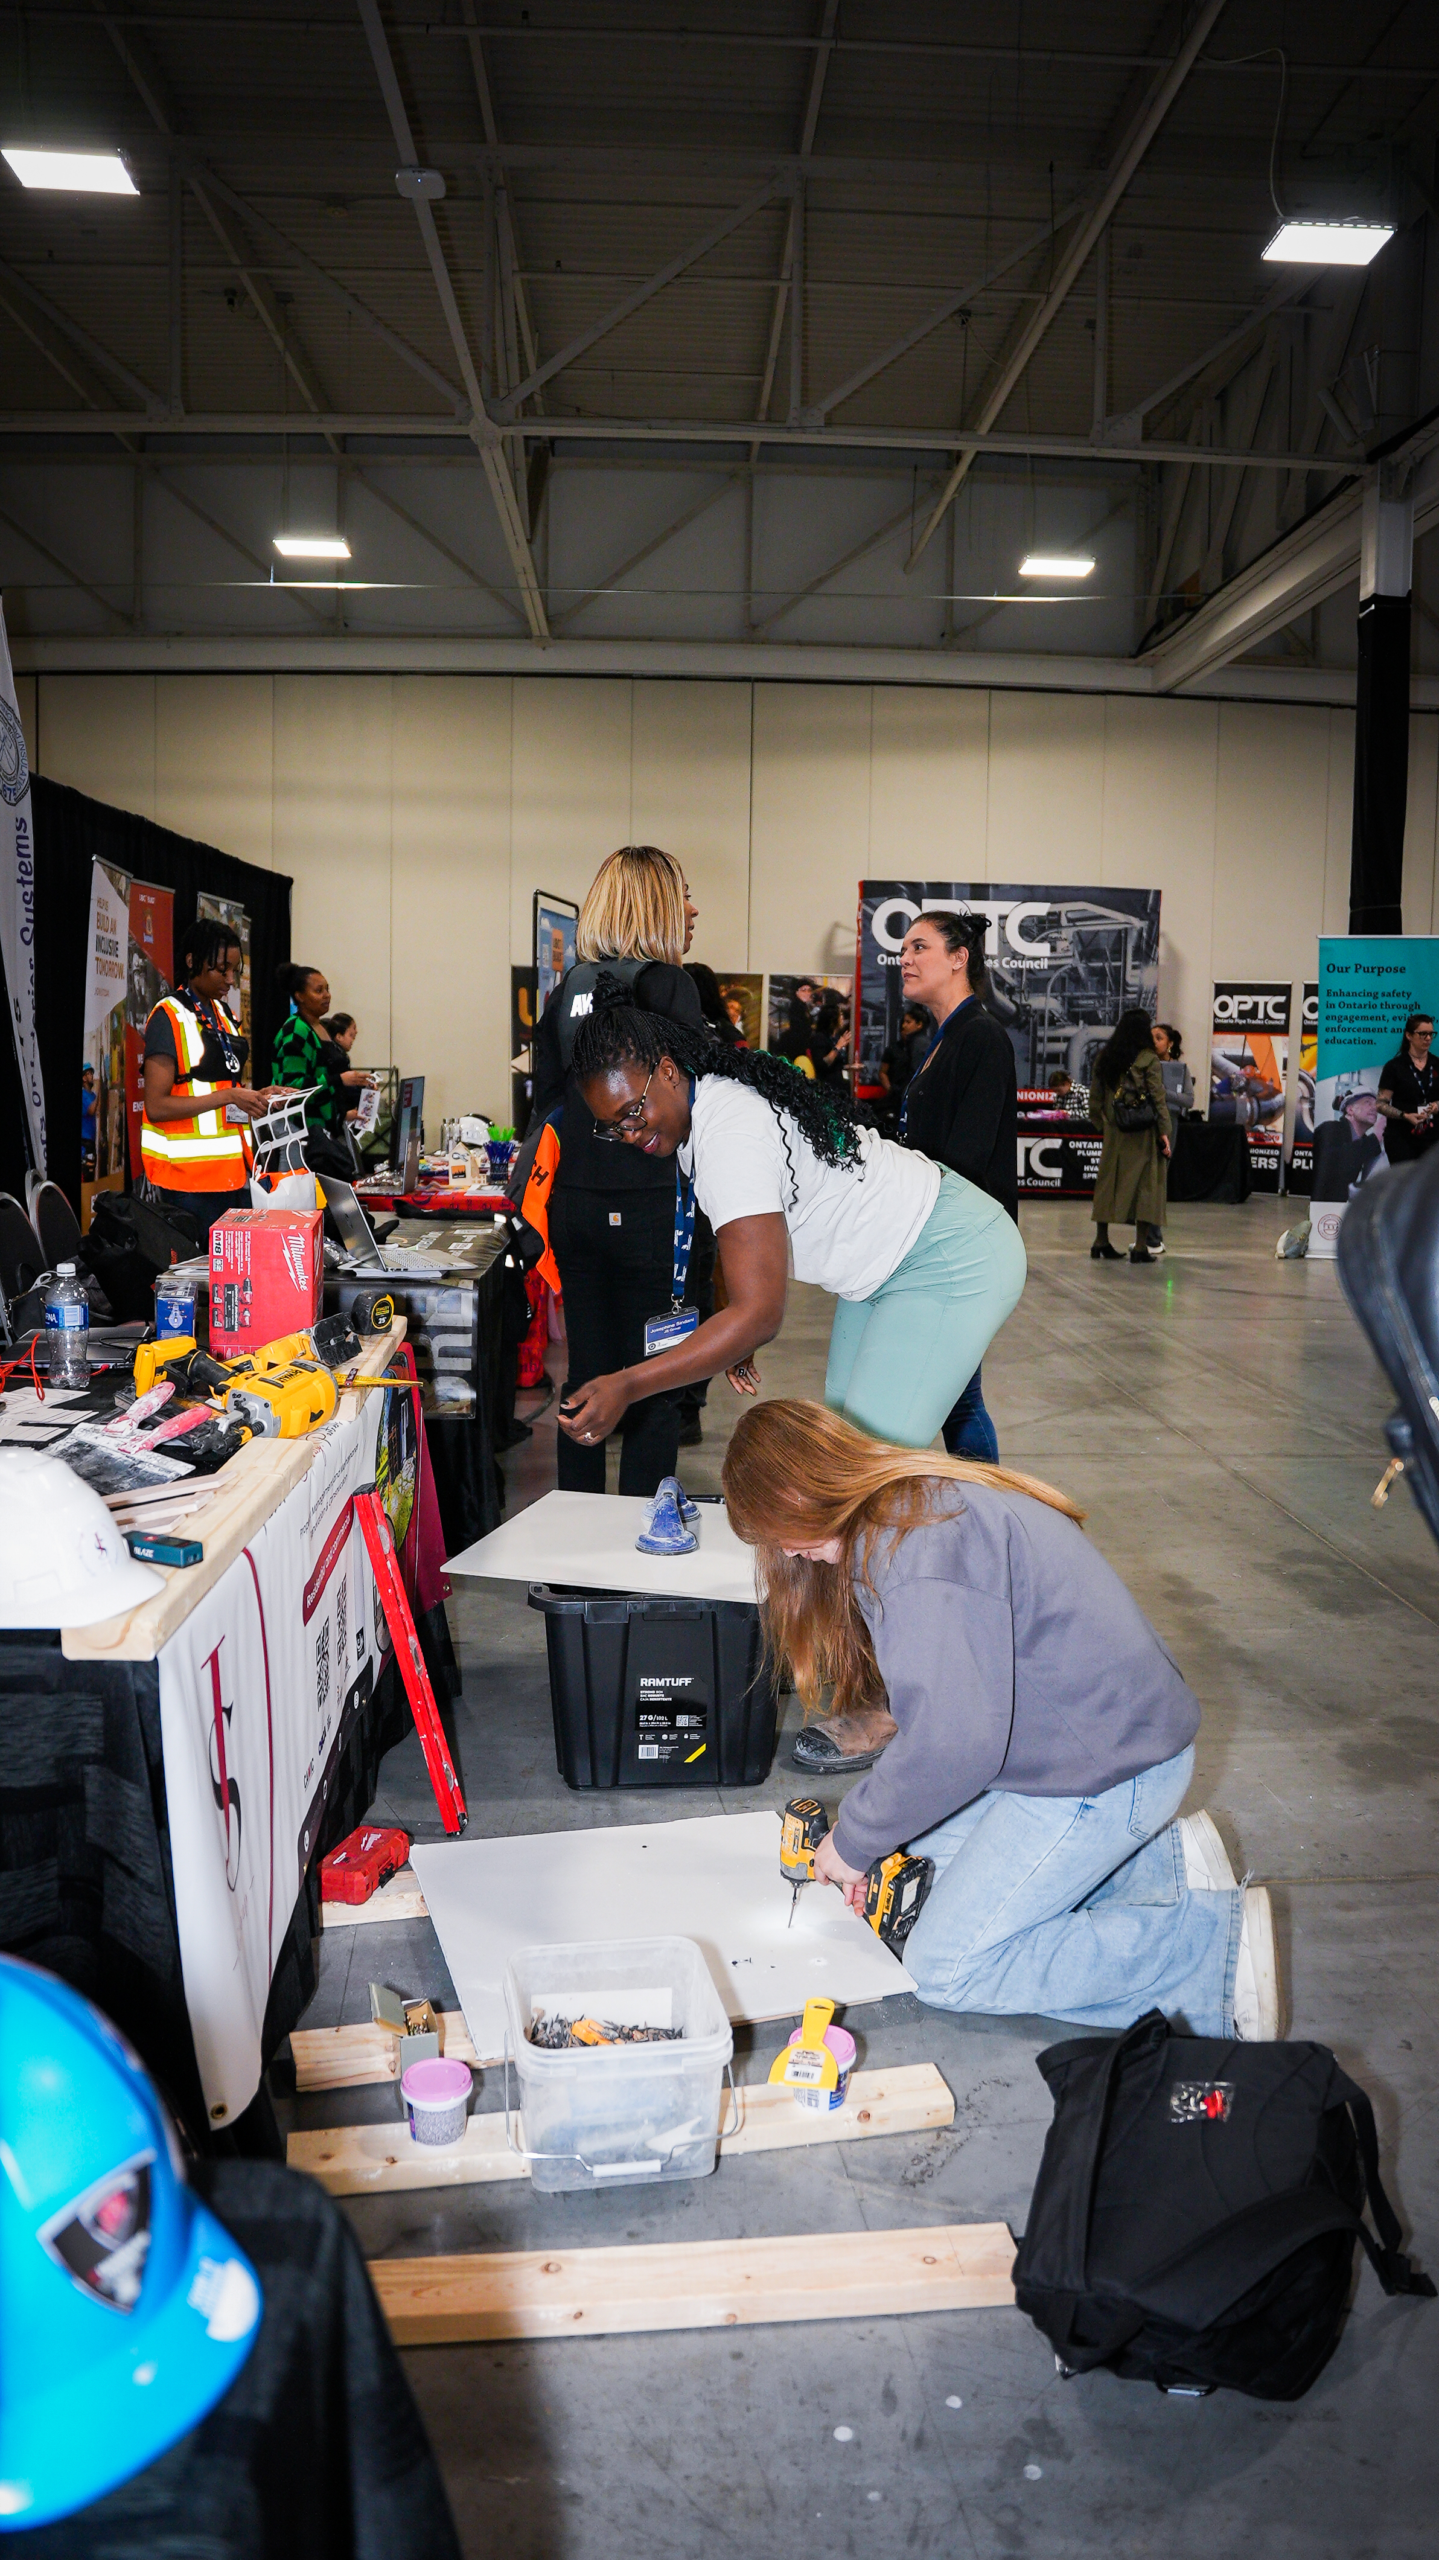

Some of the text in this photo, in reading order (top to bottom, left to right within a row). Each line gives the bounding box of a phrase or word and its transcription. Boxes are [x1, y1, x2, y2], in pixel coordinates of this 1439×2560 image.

[1002, 956, 1049, 970] Council
[1326, 963, 1407, 977] Our Purpose
[1326, 988, 1412, 1000] Enhancing safety
[1213, 994, 1287, 1020] OPTC
[1325, 1001, 1421, 1013] in Ontario through
[1264, 1018, 1285, 1026] Council
[1325, 1013, 1439, 1024] engagement, evie,
[1325, 1024, 1388, 1034] enforcement
[1324, 1036, 1377, 1046] education.
[1017, 1091, 1057, 1102] NIONIZ
[1017, 1137, 1103, 1178] TC ONTARI
[1249, 1148, 1280, 1156] IONIZED
[1250, 1156, 1278, 1170] ERS
[1026, 1178, 1061, 1188] Council
[214, 1231, 222, 1255] M18
[286, 1232, 309, 1292] Milwaukee
[639, 1677, 692, 1688] RAMTUFF
